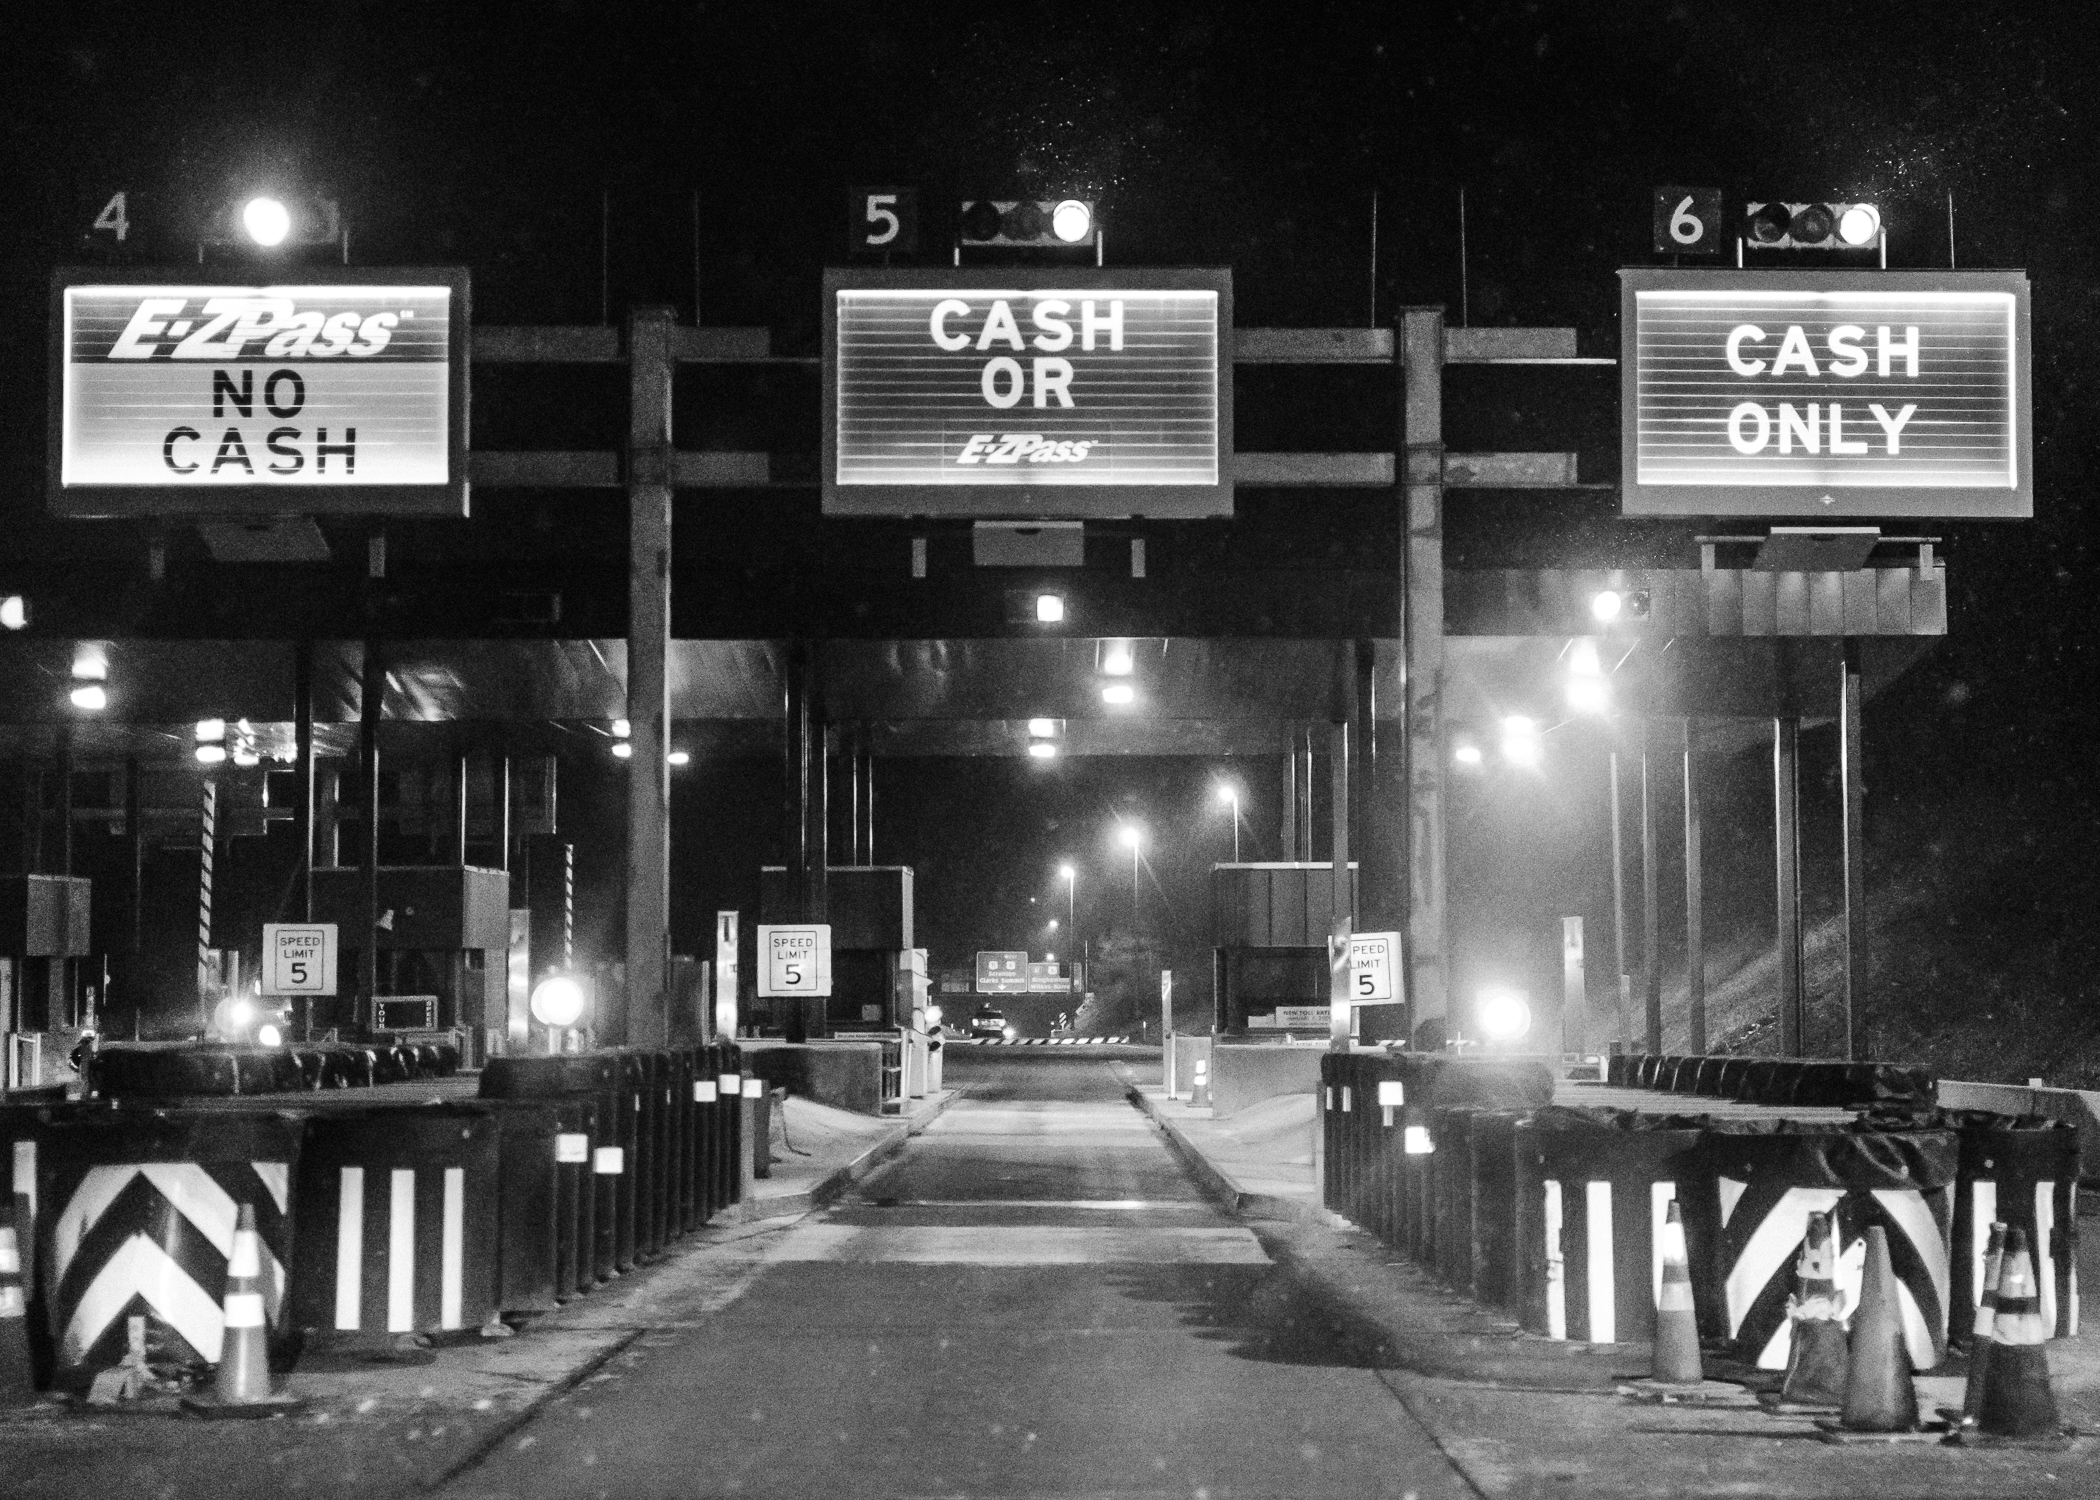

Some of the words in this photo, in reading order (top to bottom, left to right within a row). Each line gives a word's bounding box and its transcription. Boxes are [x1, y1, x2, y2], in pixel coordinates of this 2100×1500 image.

[94, 192, 129, 241] 4
[866, 194, 899, 245] 5
[1669, 196, 1704, 244] 6
[107, 299, 399, 359] E-ZPass
[930, 299, 1124, 351] CASH
[1726, 324, 1919, 377] CASH
[213, 369, 305, 419] NO
[981, 356, 1075, 409] OR
[163, 426, 356, 475] CASH
[956, 434, 1092, 464] E-ZPass
[1728, 402, 1918, 454] ONLY
[280, 936, 321, 947] SPEED
[283, 949, 314, 959] LIMIT
[773, 938, 813, 948] SPEED
[777, 951, 808, 960] LIMIT
[1352, 944, 1385, 954] PEED
[291, 962, 308, 984] 5
[785, 964, 802, 984] 5
[1359, 974, 1375, 995] 5
